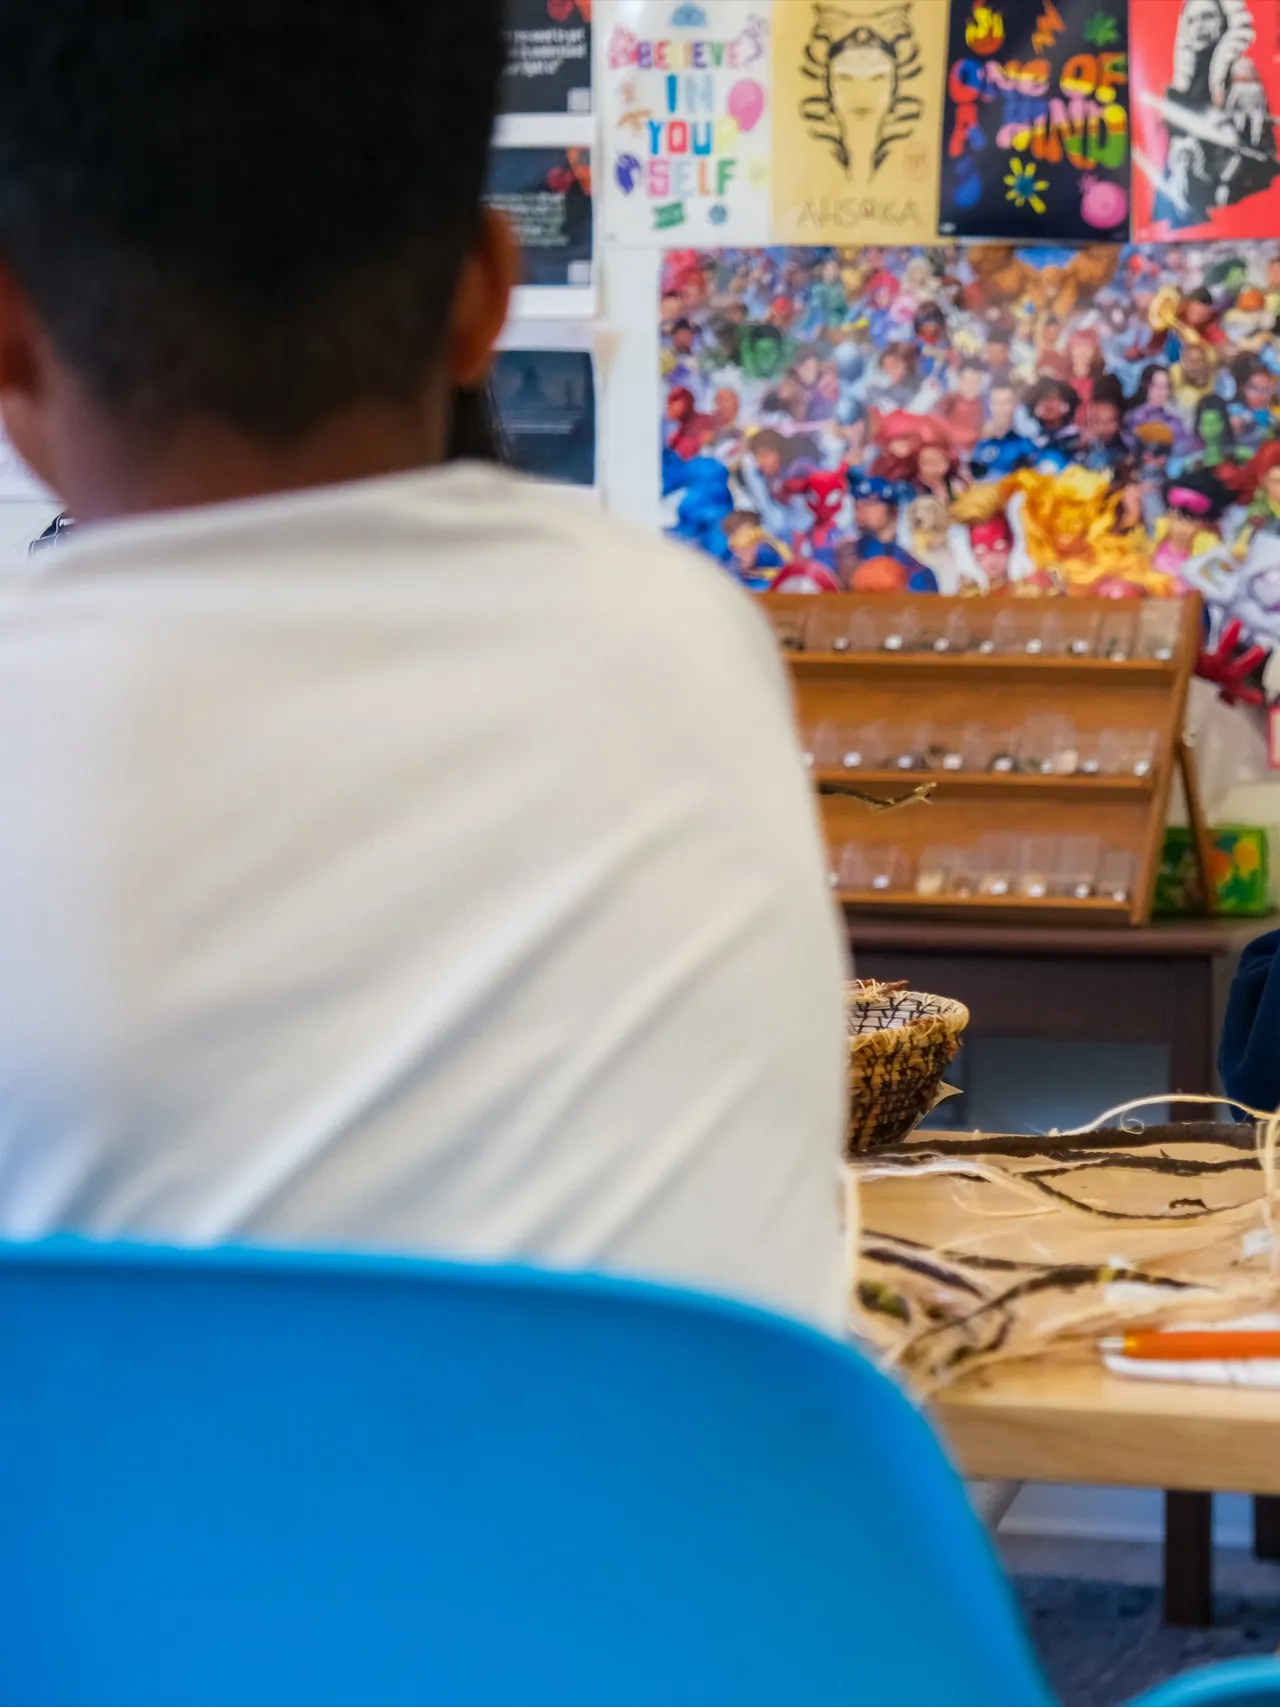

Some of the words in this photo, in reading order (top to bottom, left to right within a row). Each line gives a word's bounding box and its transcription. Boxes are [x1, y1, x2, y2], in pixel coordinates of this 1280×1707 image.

[637, 40, 743, 70] BELIEVE
[665, 74, 714, 114] IN
[949, 58, 1050, 103] ONE
[1060, 52, 1128, 97] OF
[647, 118, 738, 156] YOUR
[996, 95, 1127, 170] KIND
[646, 158, 737, 197] SELF
[797, 198, 924, 229] AHSOKA
